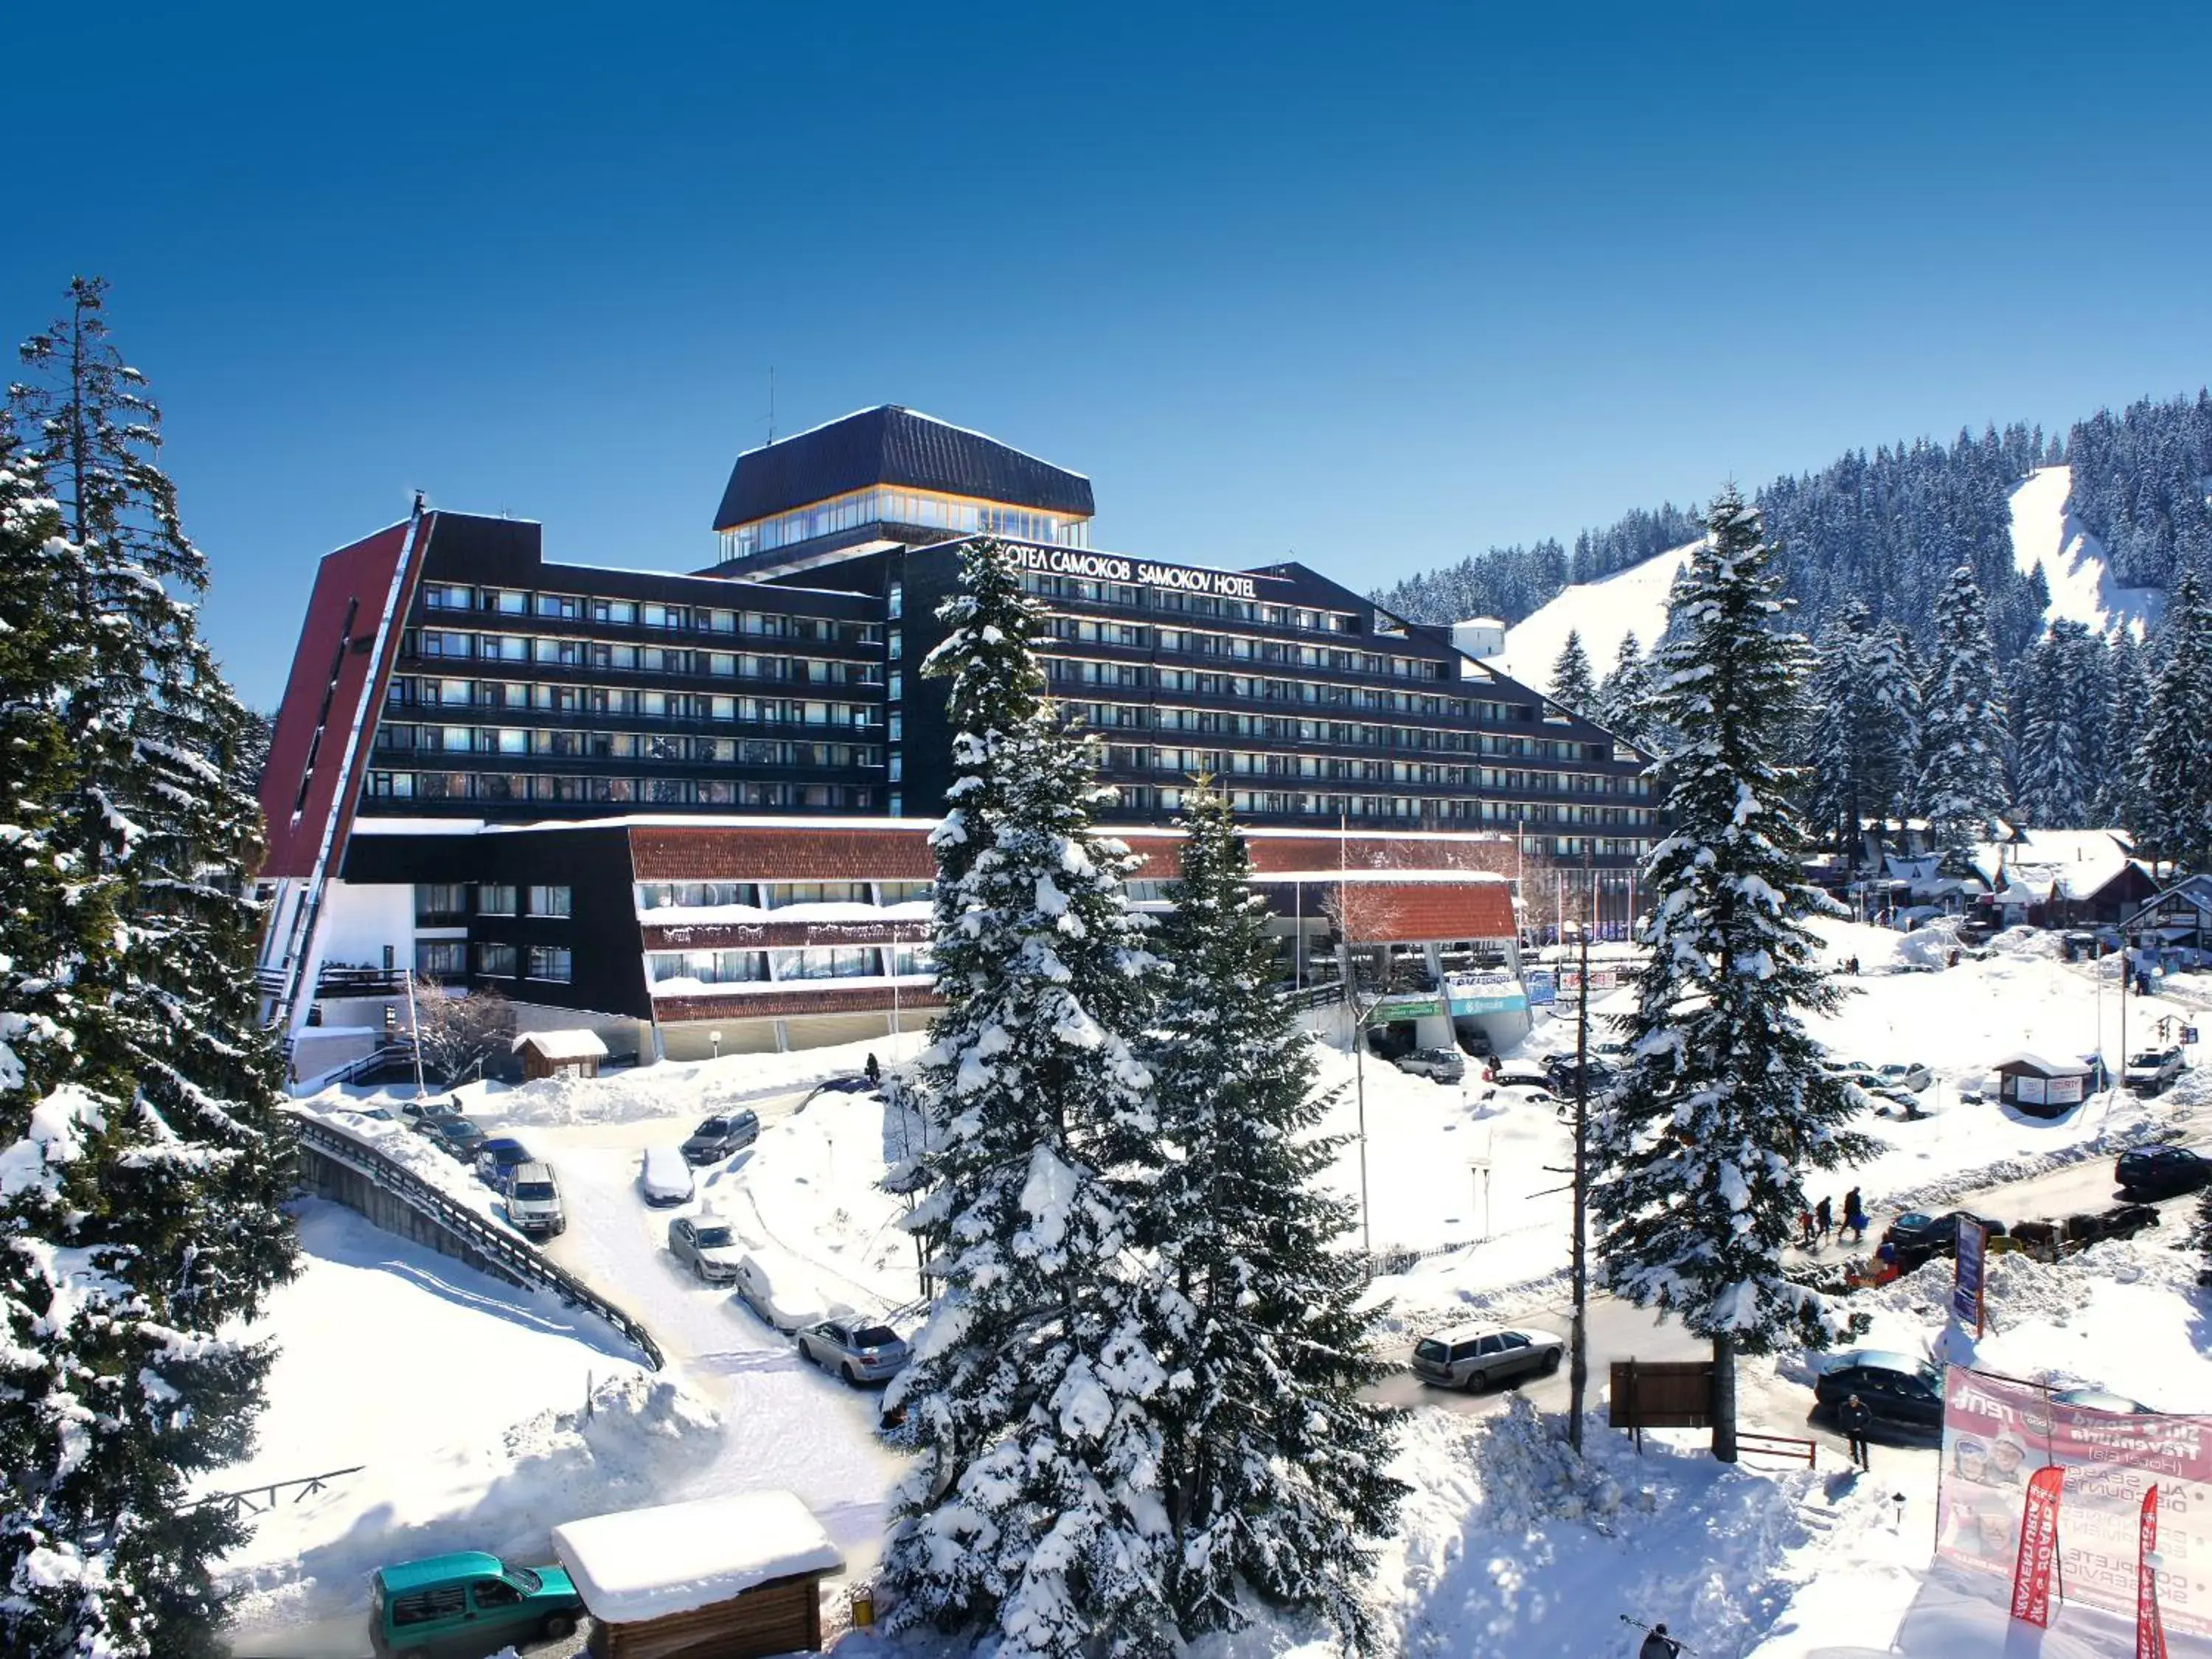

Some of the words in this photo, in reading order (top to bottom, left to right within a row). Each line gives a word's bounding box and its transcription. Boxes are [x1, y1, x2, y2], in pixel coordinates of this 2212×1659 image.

[1003, 544, 1048, 569] ОТЕЛ
[1050, 552, 1130, 581] САМОКОВ
[1138, 563, 1211, 590] SAMOKOV
[1214, 574, 1256, 598] HOTEL
